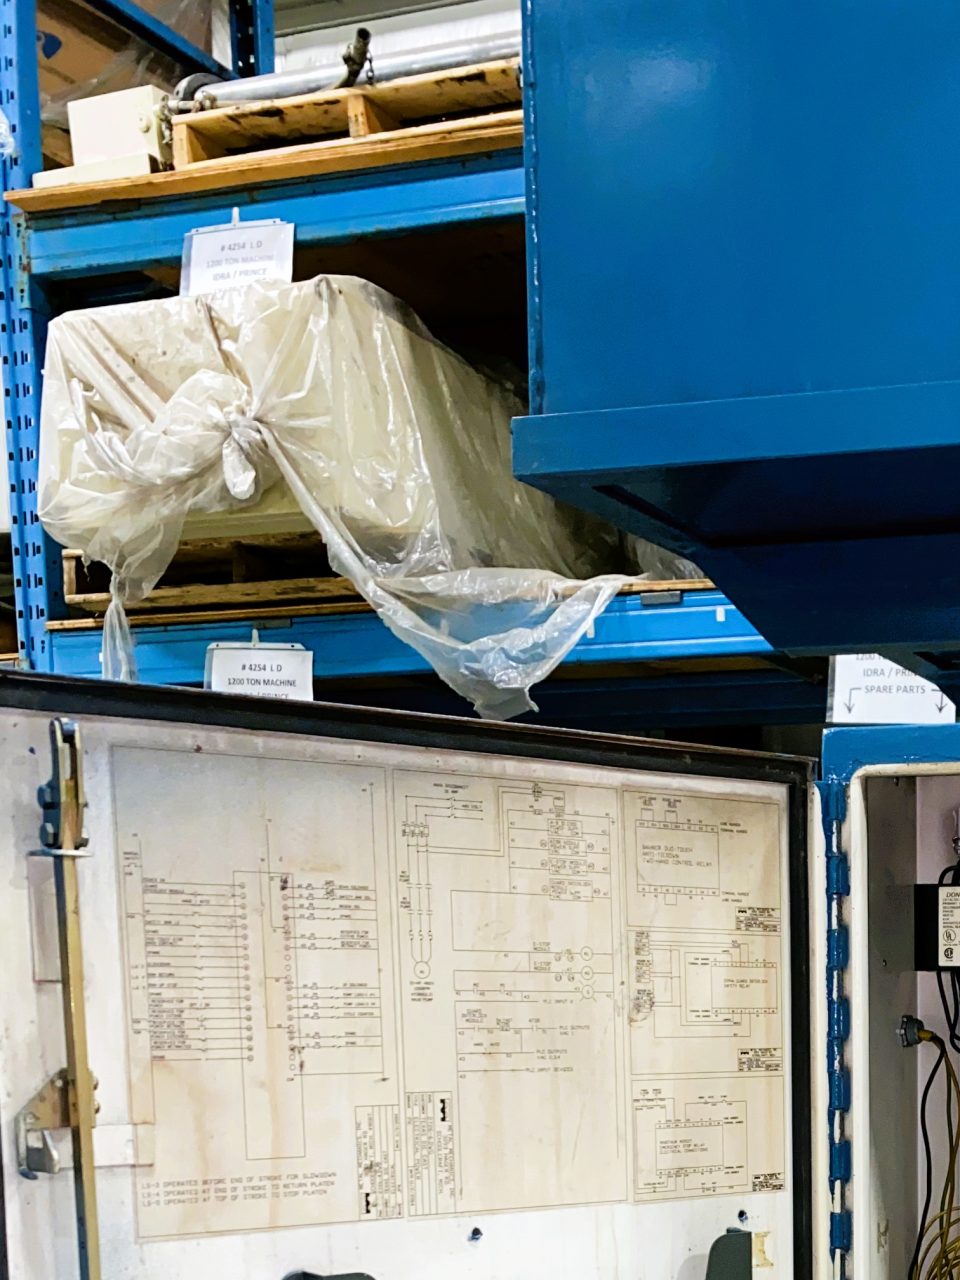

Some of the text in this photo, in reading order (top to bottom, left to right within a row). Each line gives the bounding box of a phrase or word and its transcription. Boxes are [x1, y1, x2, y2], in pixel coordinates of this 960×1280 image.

[248, 664, 266, 672] 4254
[276, 664, 282, 672] D
[863, 668, 885, 677] IDRA
[227, 677, 297, 687] 1200 TON MACHINE
[864, 685, 926, 694] SPARE PARTS
